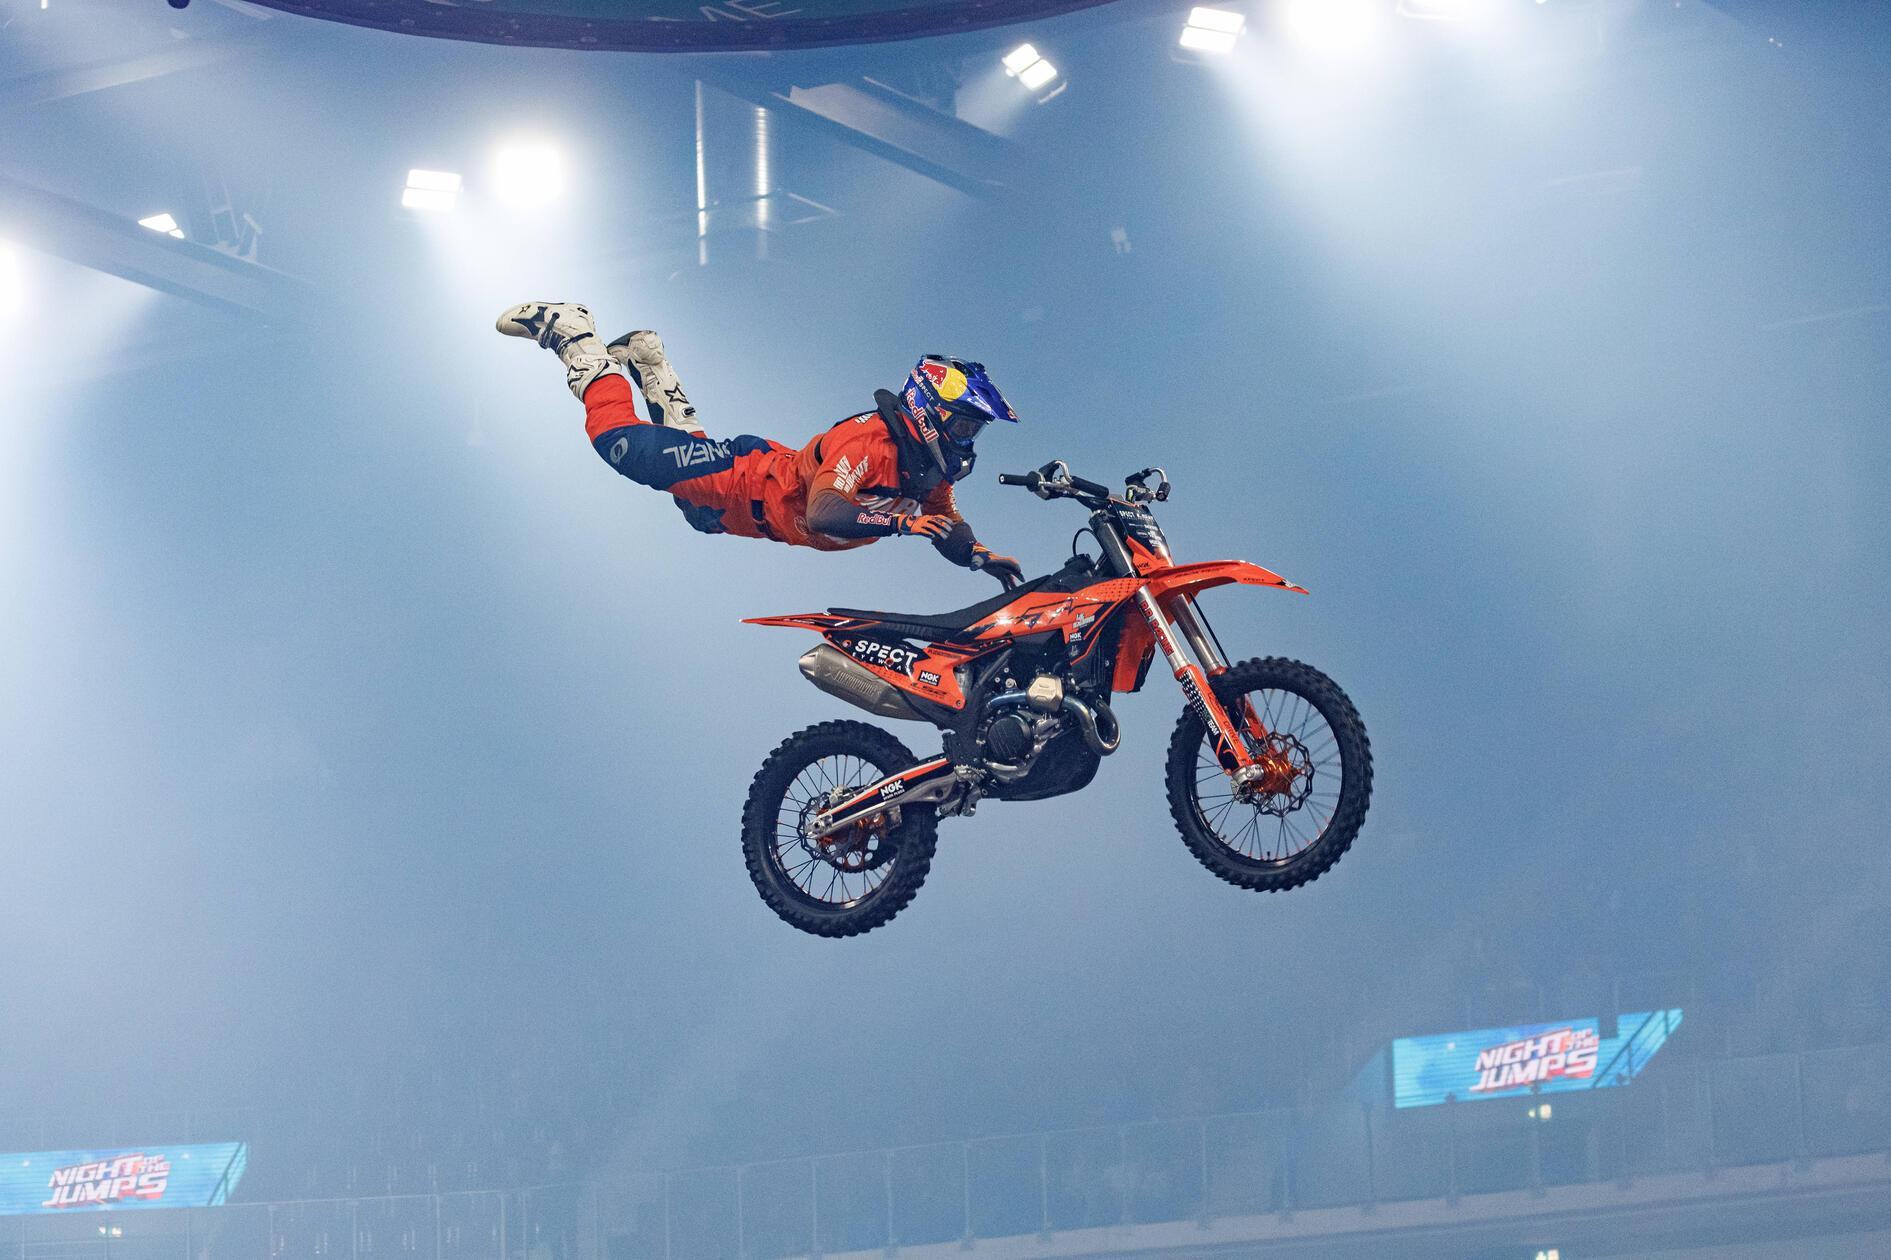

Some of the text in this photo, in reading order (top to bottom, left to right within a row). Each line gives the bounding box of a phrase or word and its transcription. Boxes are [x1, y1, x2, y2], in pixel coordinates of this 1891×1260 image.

[855, 640, 918, 668] SPECT
[920, 670, 940, 683] NGK
[880, 779, 904, 797] NGK
[1475, 1027, 1571, 1071] NIGHT
[1469, 1047, 1599, 1091] JUMPS
[48, 1152, 144, 1187] NIGHT
[42, 1171, 169, 1207] JUMPS
